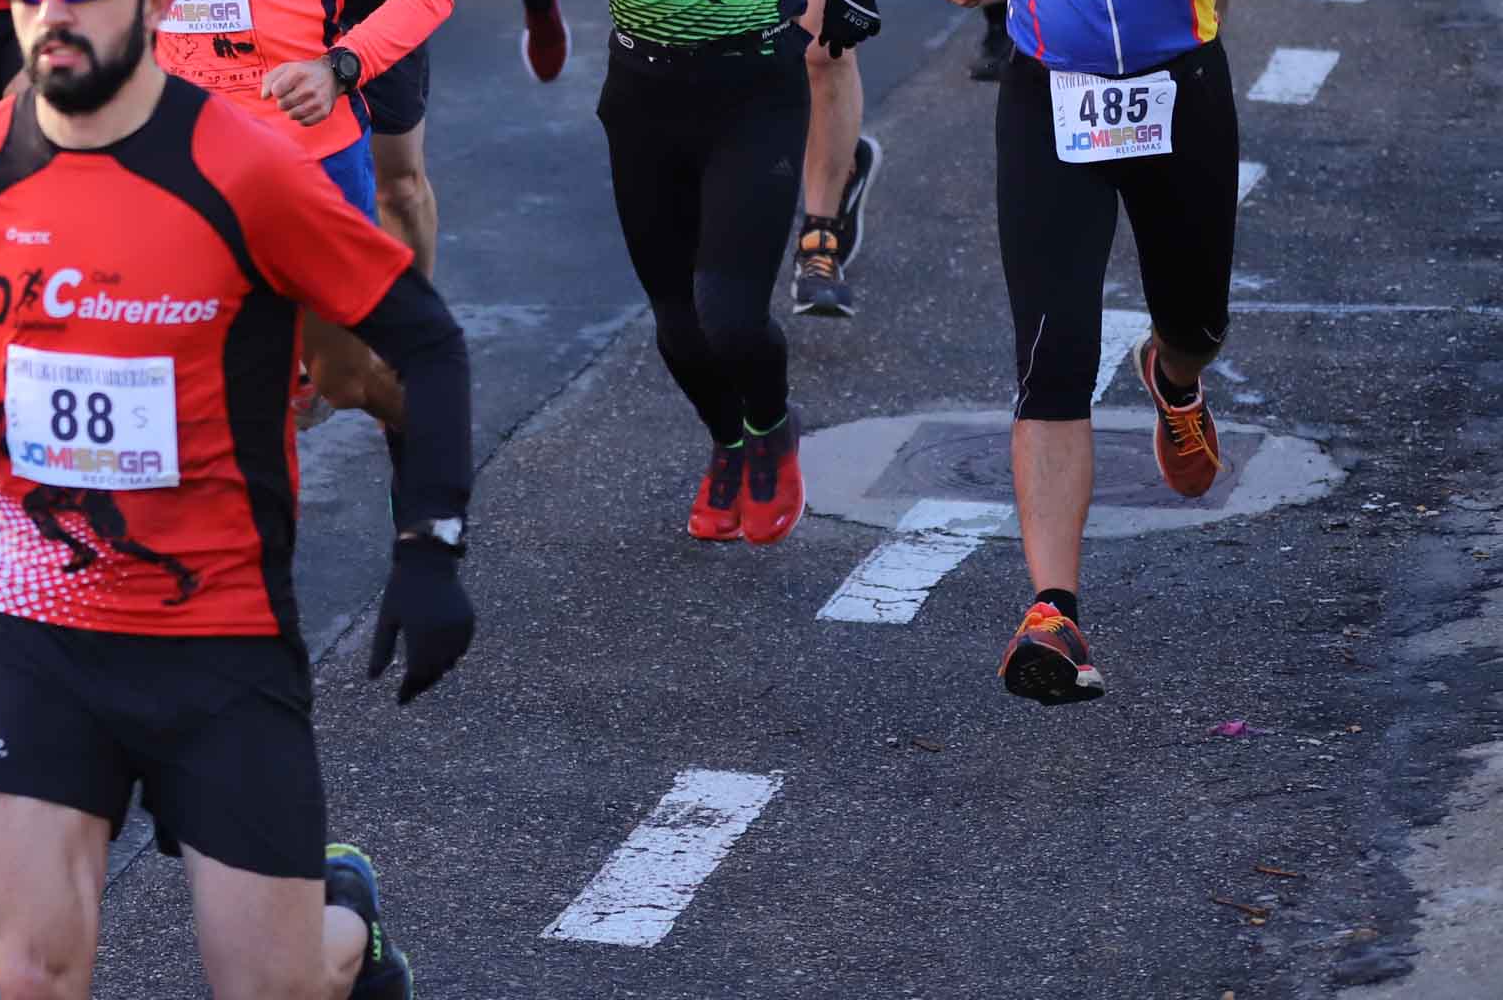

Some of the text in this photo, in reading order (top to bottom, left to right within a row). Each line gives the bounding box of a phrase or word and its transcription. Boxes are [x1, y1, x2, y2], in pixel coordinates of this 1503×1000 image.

[165, 2, 241, 21] MISAGA
[188, 22, 241, 30] REFORMAS
[1079, 87, 1150, 128] 485
[1065, 123, 1163, 151] JOMISAGA
[1115, 142, 1162, 154] REFORMAS
[42, 267, 220, 325] Cabrerizos
[50, 388, 115, 445] 88
[19, 442, 163, 473] JOMISAGA
